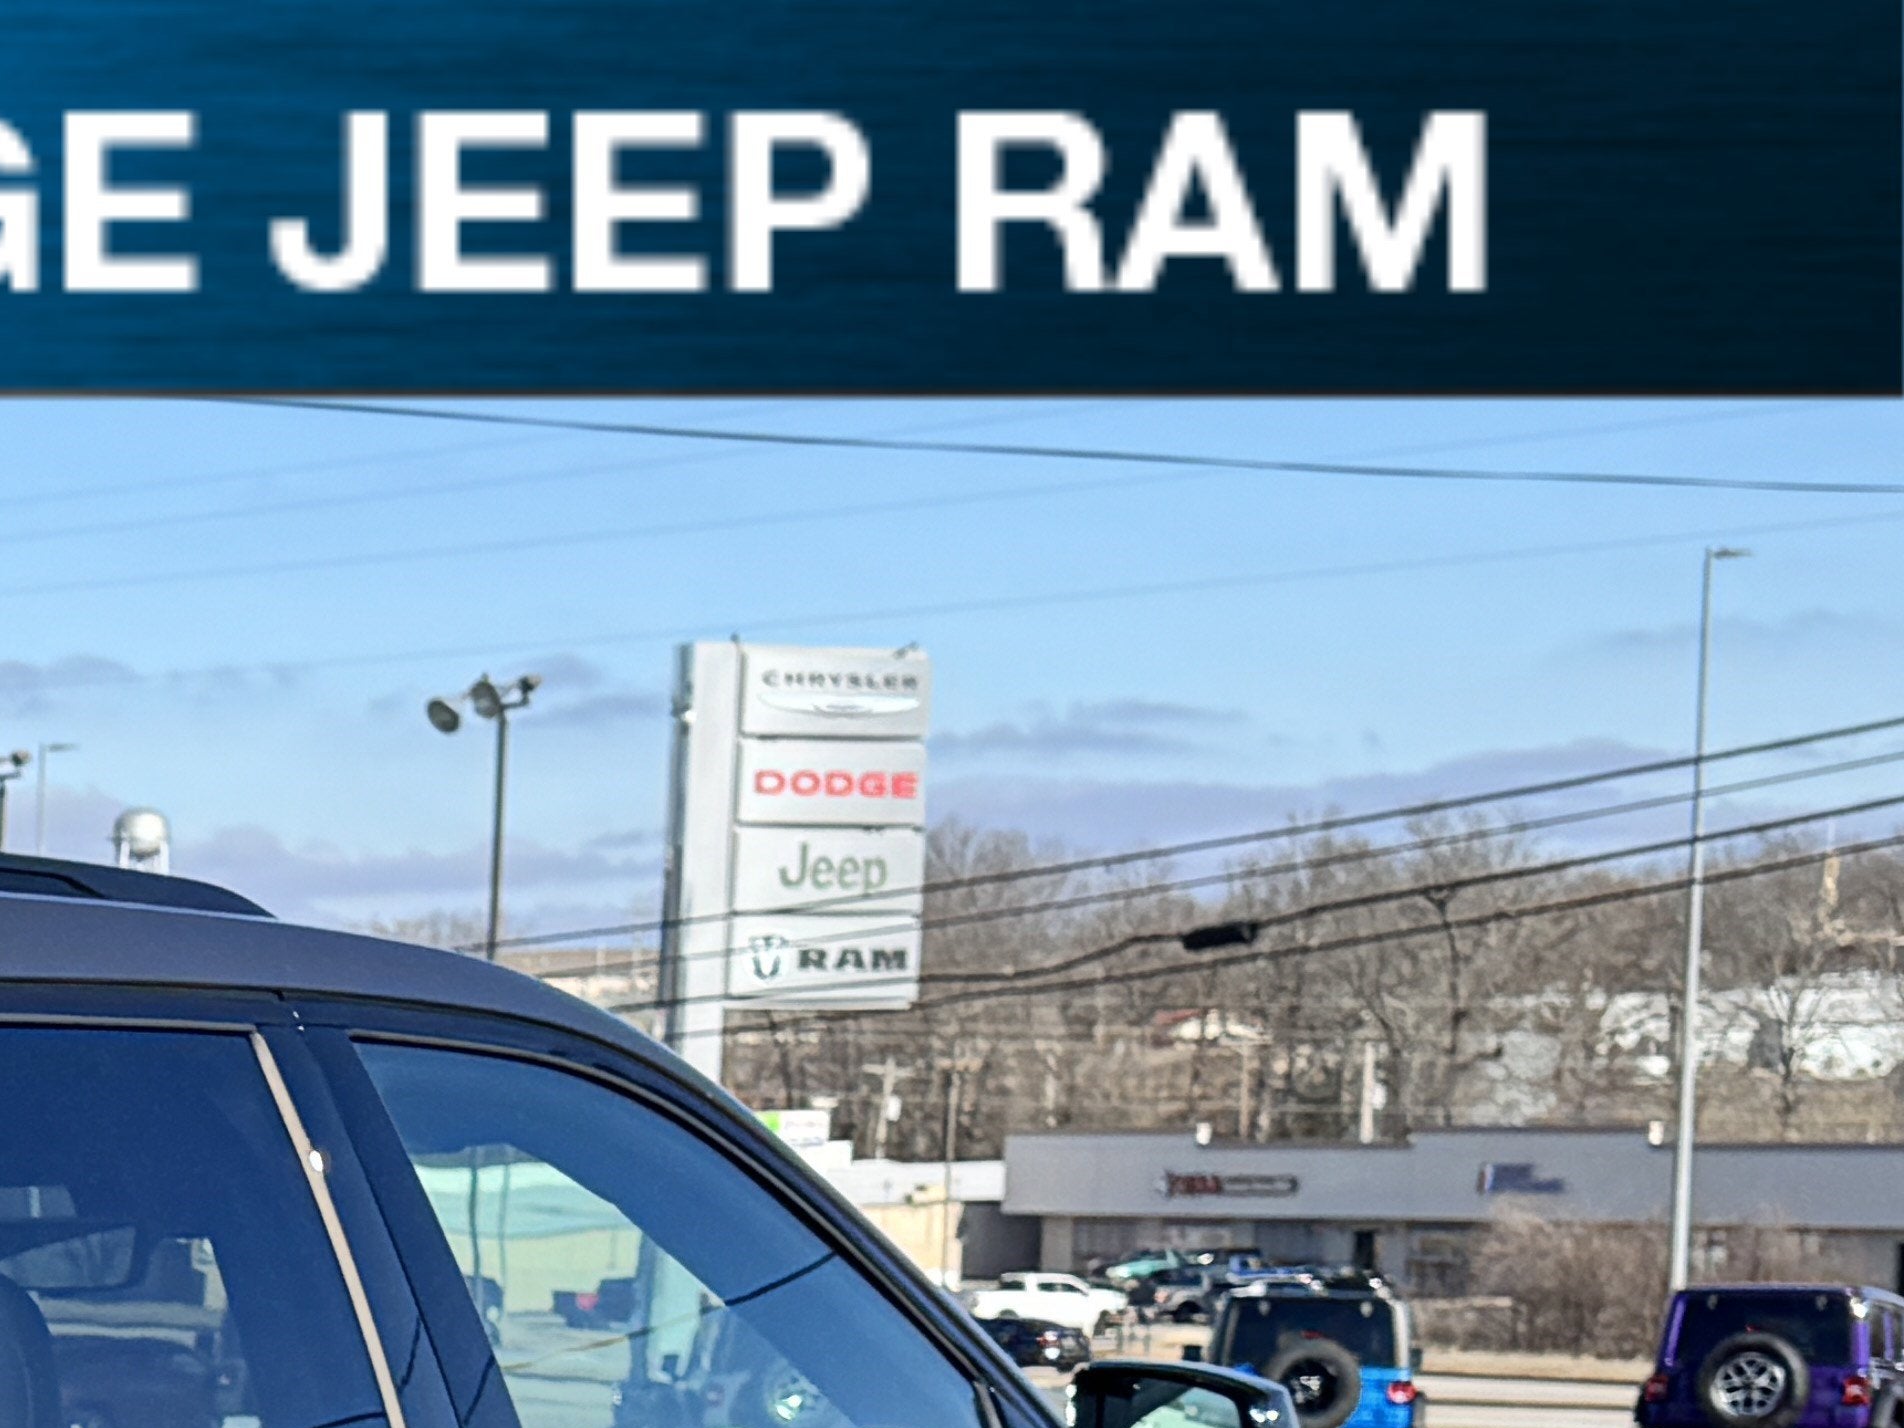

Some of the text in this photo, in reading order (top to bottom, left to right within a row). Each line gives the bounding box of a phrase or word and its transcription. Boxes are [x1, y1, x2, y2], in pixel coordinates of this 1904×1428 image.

[761, 669, 919, 690] CHRYSLER
[753, 769, 920, 800] DODGE
[778, 841, 888, 893] Jeep
[797, 947, 909, 972] RAM
